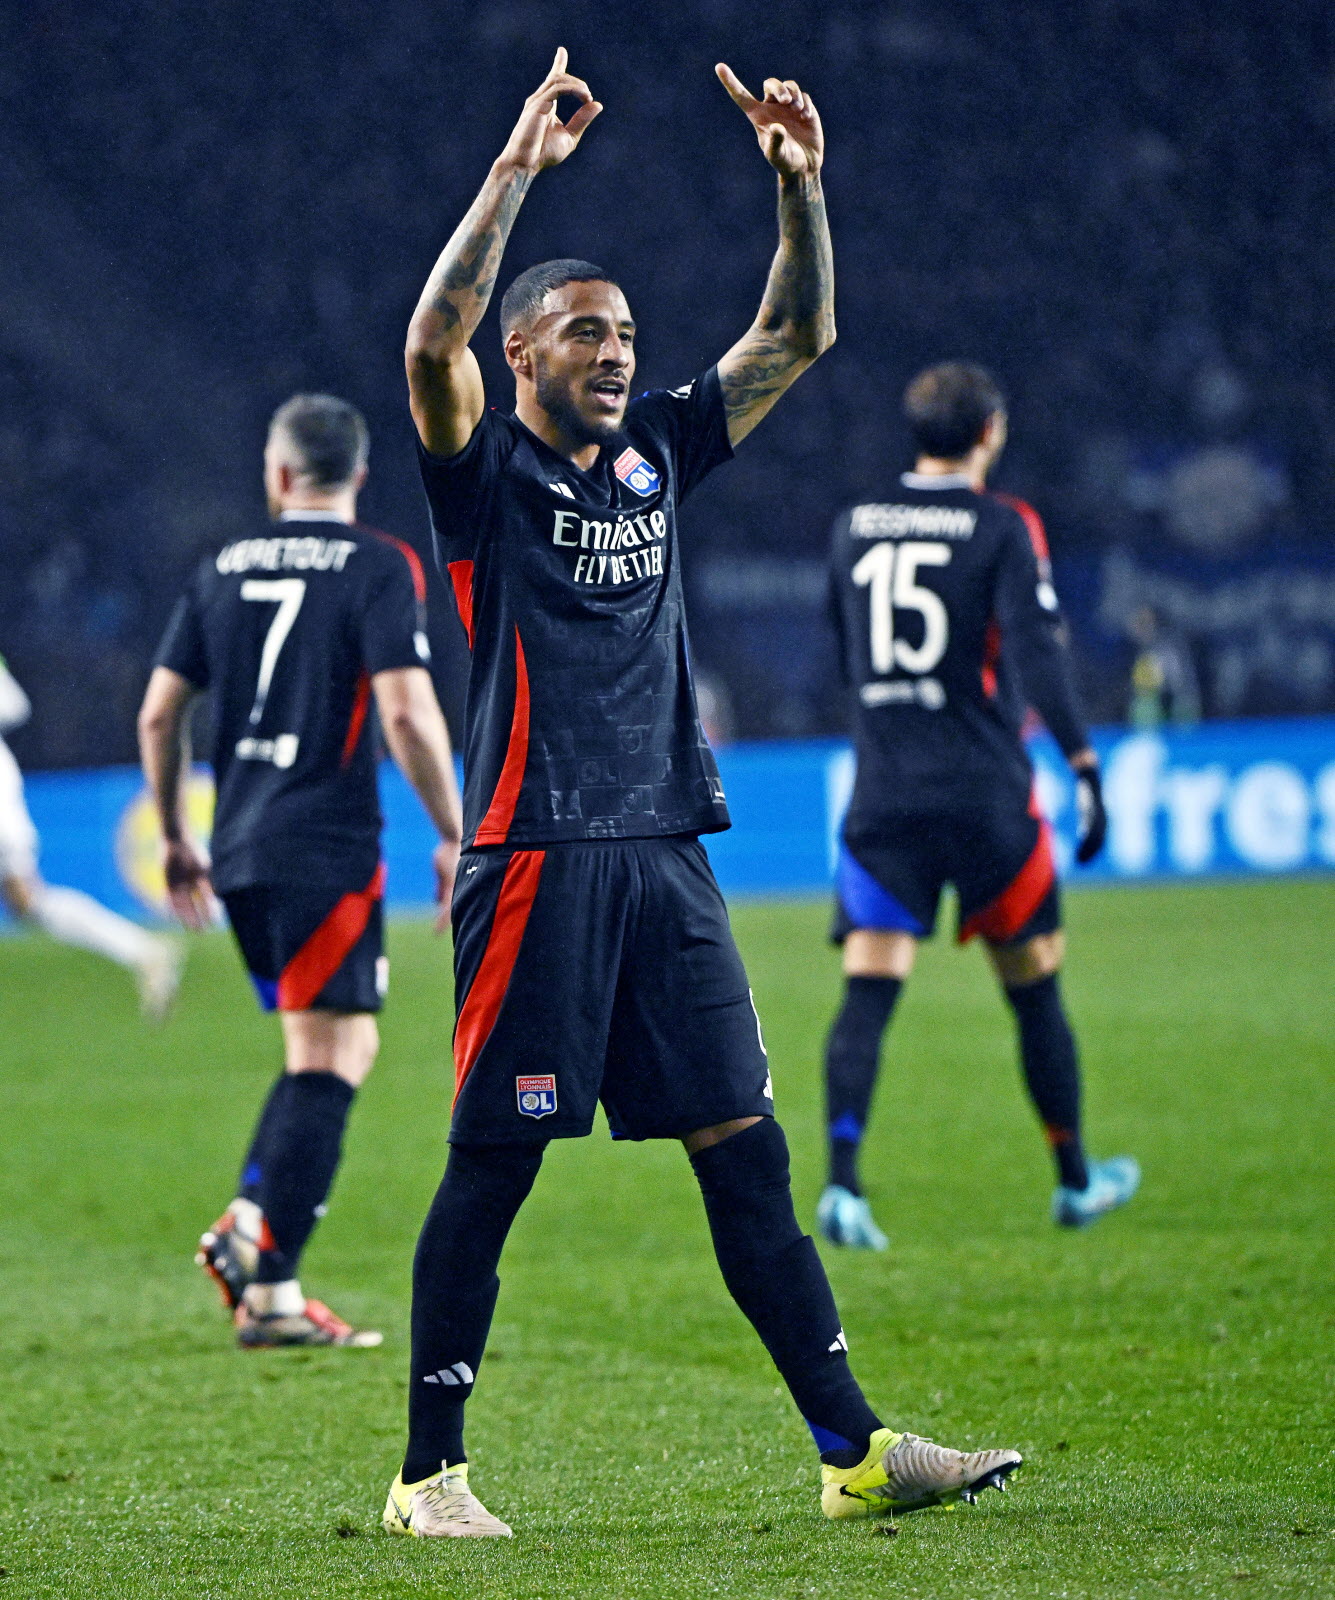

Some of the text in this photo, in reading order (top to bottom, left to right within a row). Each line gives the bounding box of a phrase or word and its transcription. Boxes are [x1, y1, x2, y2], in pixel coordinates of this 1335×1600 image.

[574, 554, 607, 584] FLY
[611, 546, 663, 585] BETTER
[852, 541, 952, 675] 15
[240, 578, 306, 725] 7
[521, 1092, 552, 1110] OL
